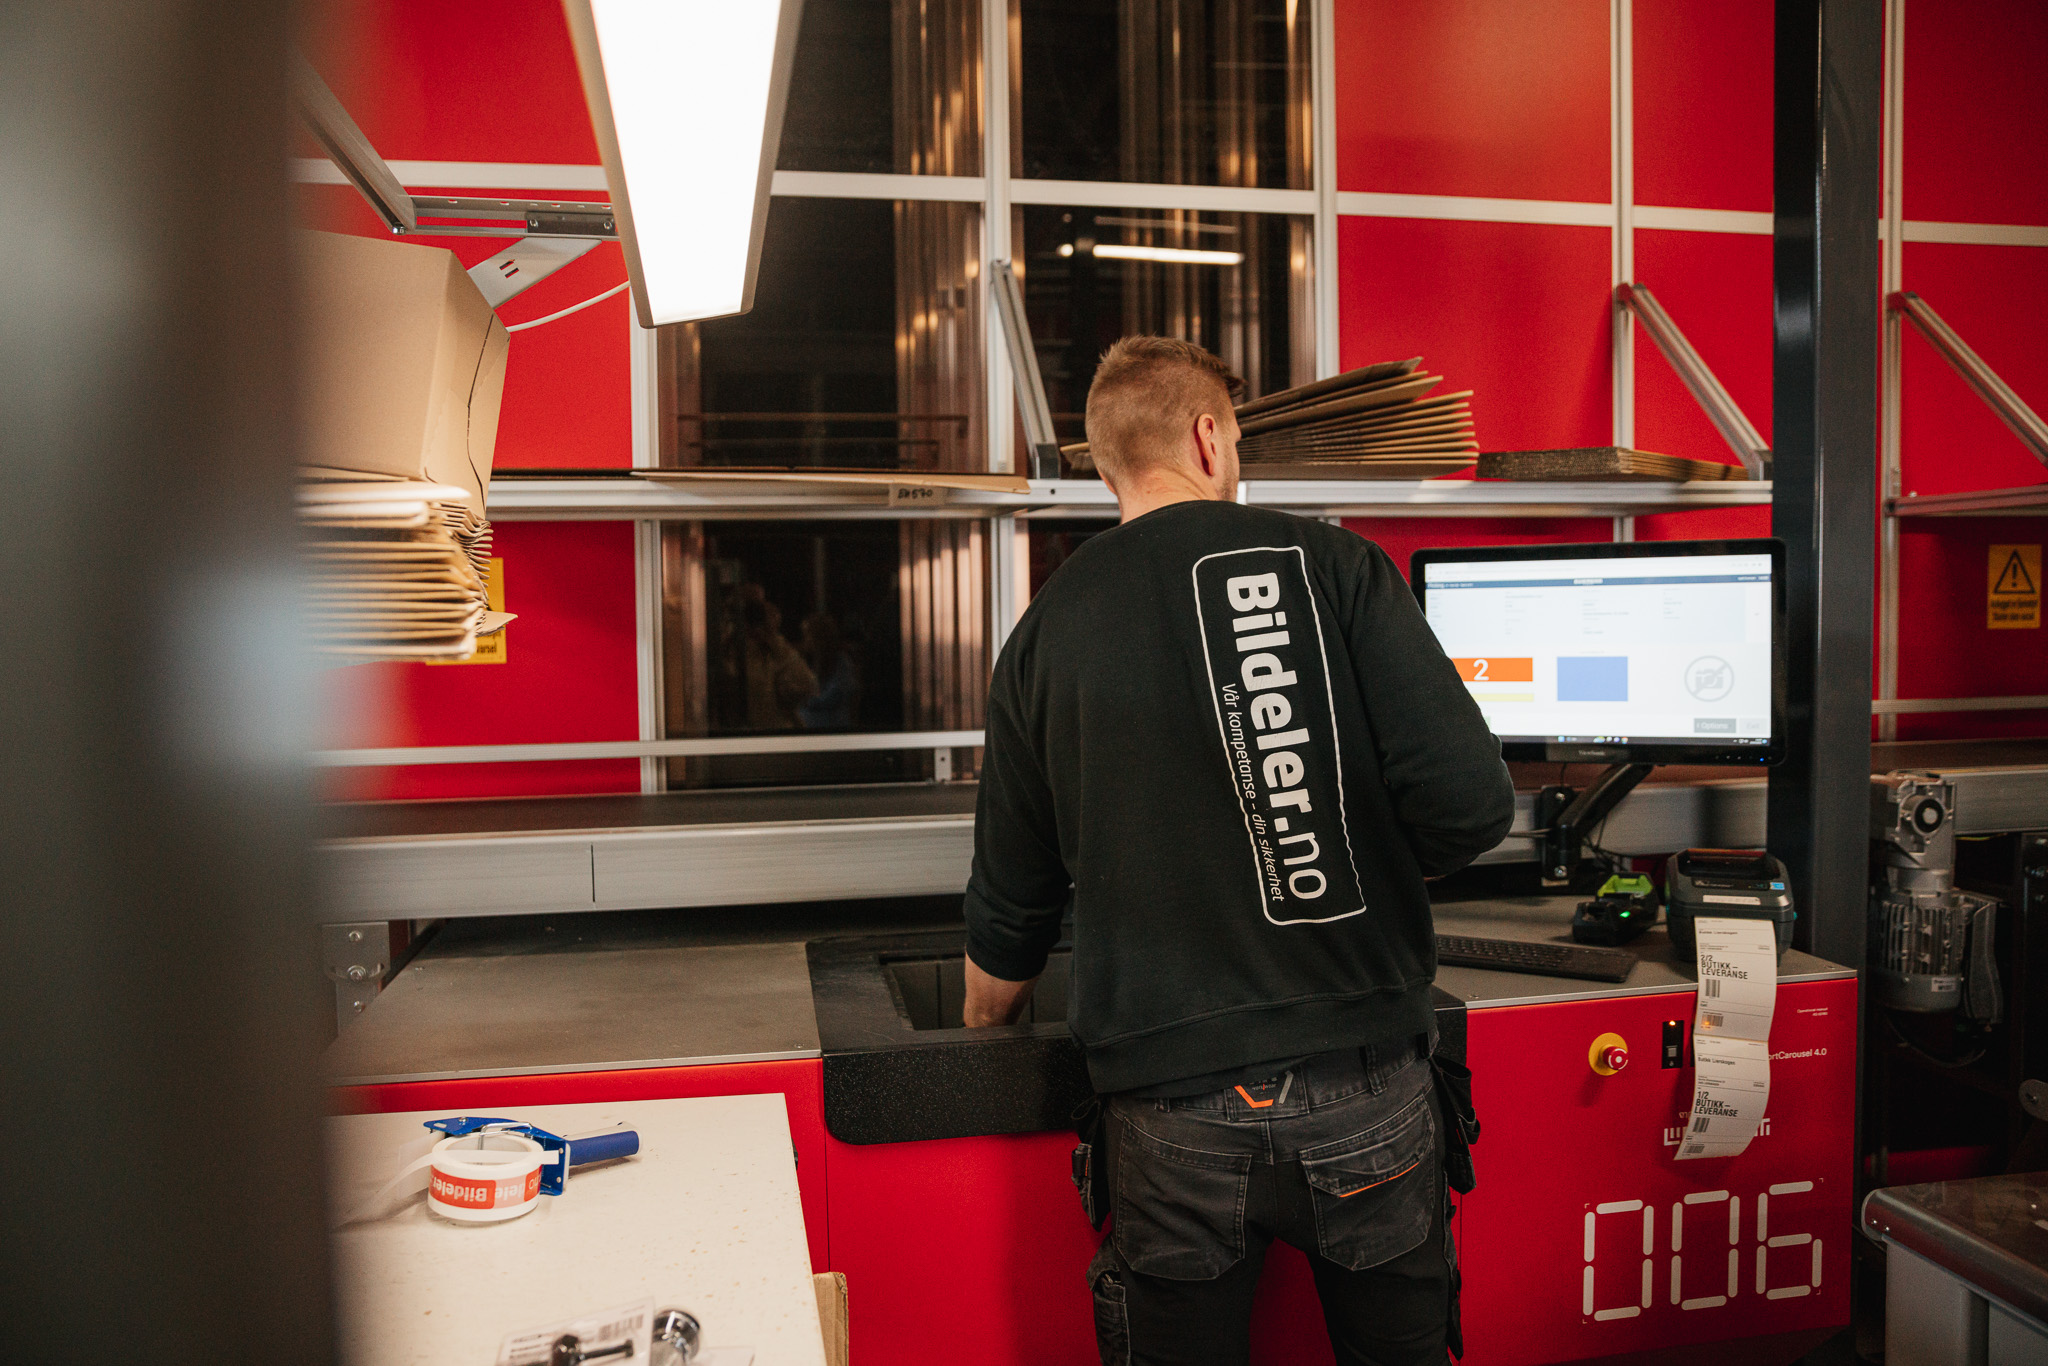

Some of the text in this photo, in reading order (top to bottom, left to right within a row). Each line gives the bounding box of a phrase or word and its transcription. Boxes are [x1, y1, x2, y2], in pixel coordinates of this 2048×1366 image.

[1473, 659, 1489, 681] 2
[1222, 683, 1240, 708] Vår
[1226, 572, 1327, 899] Bildeler.no
[1227, 711, 1257, 799] kompetanse
[1252, 813, 1267, 835] din
[1259, 838, 1285, 902] sikkerhet
[1701, 968, 1748, 980] LEVERANSE
[1768, 1048, 1827, 1060] ortCarousel 4.0
[1697, 1091, 1709, 1099] 1/2
[1694, 1107, 1738, 1117] LEVERANSE
[1583, 1181, 1822, 1321] 006
